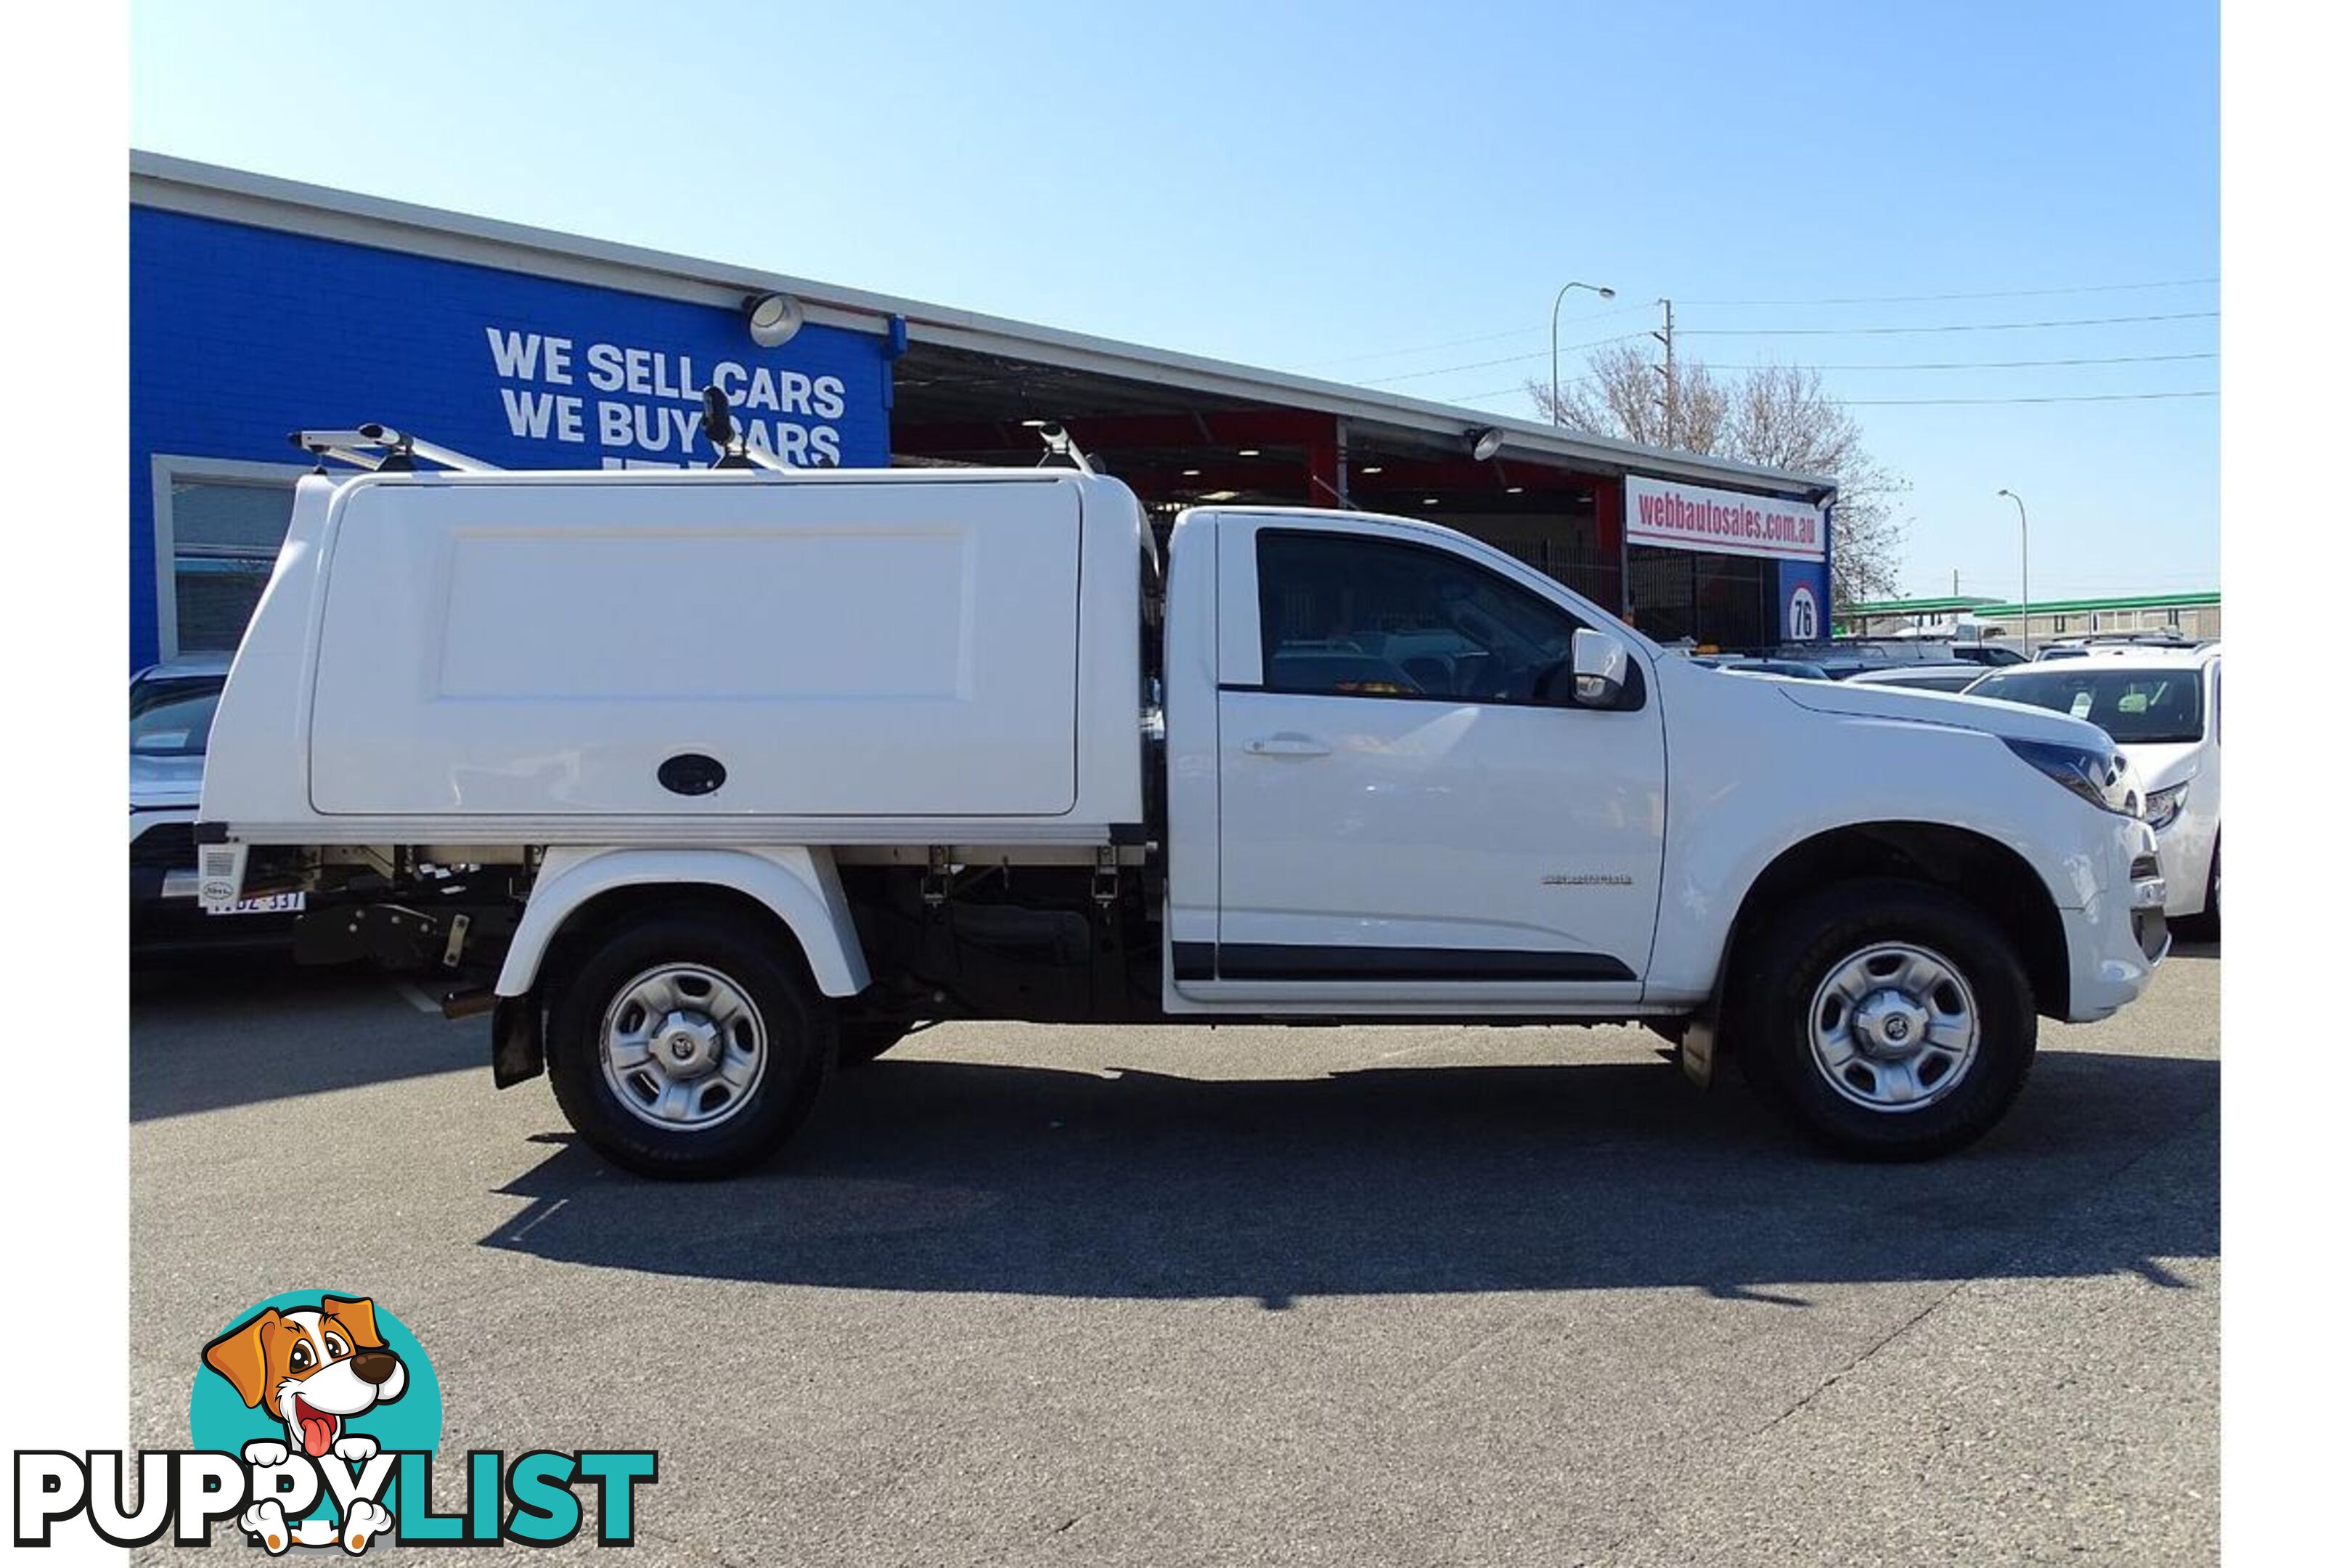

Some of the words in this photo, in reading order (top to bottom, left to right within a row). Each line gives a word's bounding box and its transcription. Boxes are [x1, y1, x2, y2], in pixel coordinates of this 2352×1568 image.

[486, 327, 573, 385] WE
[587, 343, 704, 401] SELL
[713, 362, 845, 420] CARS
[501, 389, 584, 442] WE
[597, 401, 703, 454] BUY
[1638, 491, 1816, 544] webbautosales.com.au
[1794, 600, 1813, 637] 76
